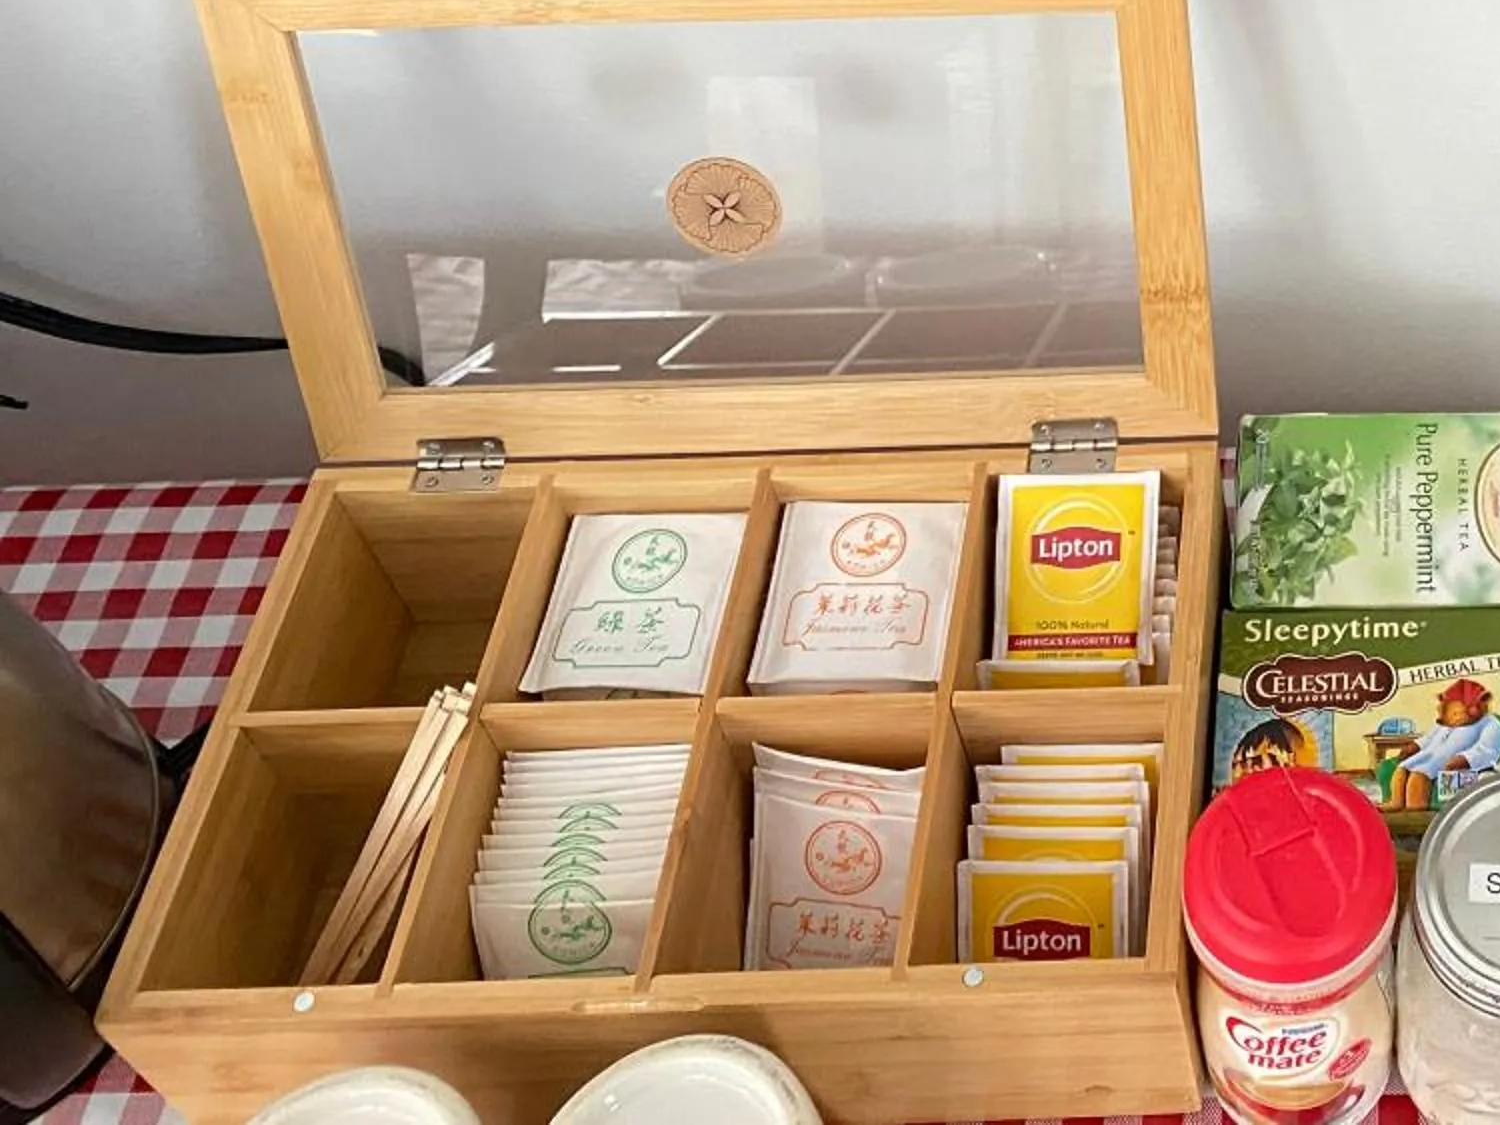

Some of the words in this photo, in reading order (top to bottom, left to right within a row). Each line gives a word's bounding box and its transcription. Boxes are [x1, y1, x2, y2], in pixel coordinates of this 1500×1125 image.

[1414, 423, 1439, 467] Pure
[1457, 458, 1469, 515] HERBAL
[1408, 472, 1440, 593] Peppermint
[1457, 523, 1469, 552] TEA
[1039, 537, 1113, 562] Lipton
[1036, 620, 1069, 631] 100%
[1070, 618, 1110, 630] Natural
[1244, 618, 1421, 648] Sleepytime
[1014, 635, 1064, 648] AMERICA'S
[1064, 635, 1111, 647] FAVORITE
[1112, 634, 1131, 646] TEA
[1254, 669, 1386, 699] CELESTIAL
[1409, 657, 1479, 683] HERBAL
[1281, 691, 1360, 705] SEASONINGS
[1002, 928, 1082, 956] Lipton
[1225, 1016, 1327, 1056] Coffee
[1247, 1048, 1322, 1070] mate
